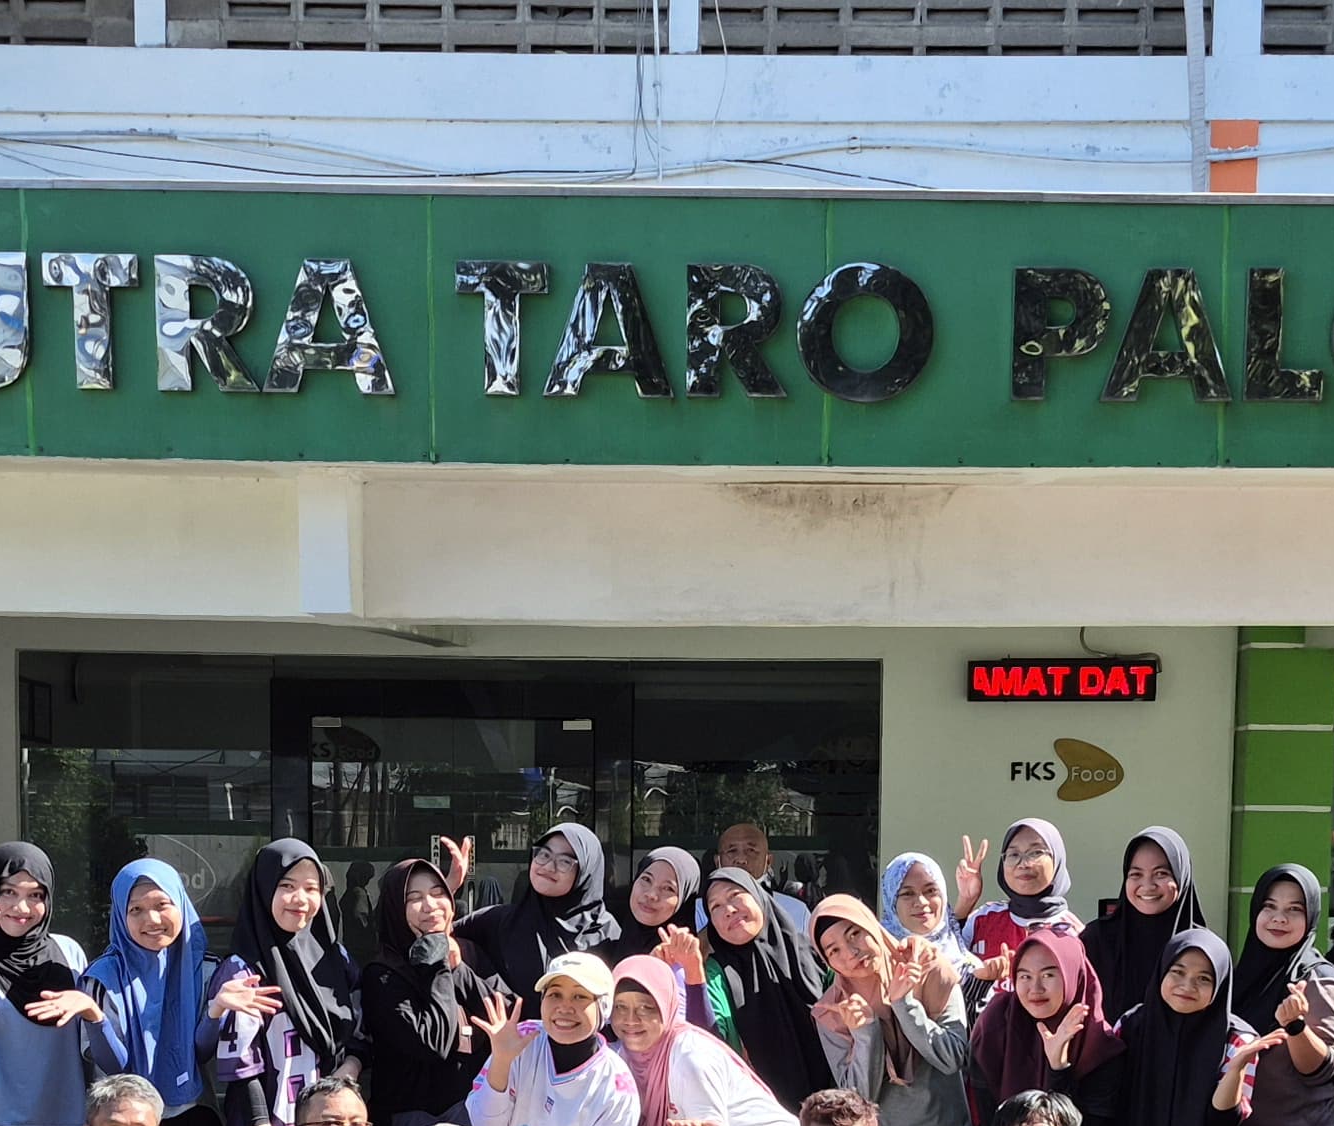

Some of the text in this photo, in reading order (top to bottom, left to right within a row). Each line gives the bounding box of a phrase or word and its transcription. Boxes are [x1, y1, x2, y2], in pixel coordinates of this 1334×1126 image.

[454, 259, 934, 403] TARO
[1078, 666, 1154, 696] DAT
[1010, 761, 1117, 782] FKS Food
